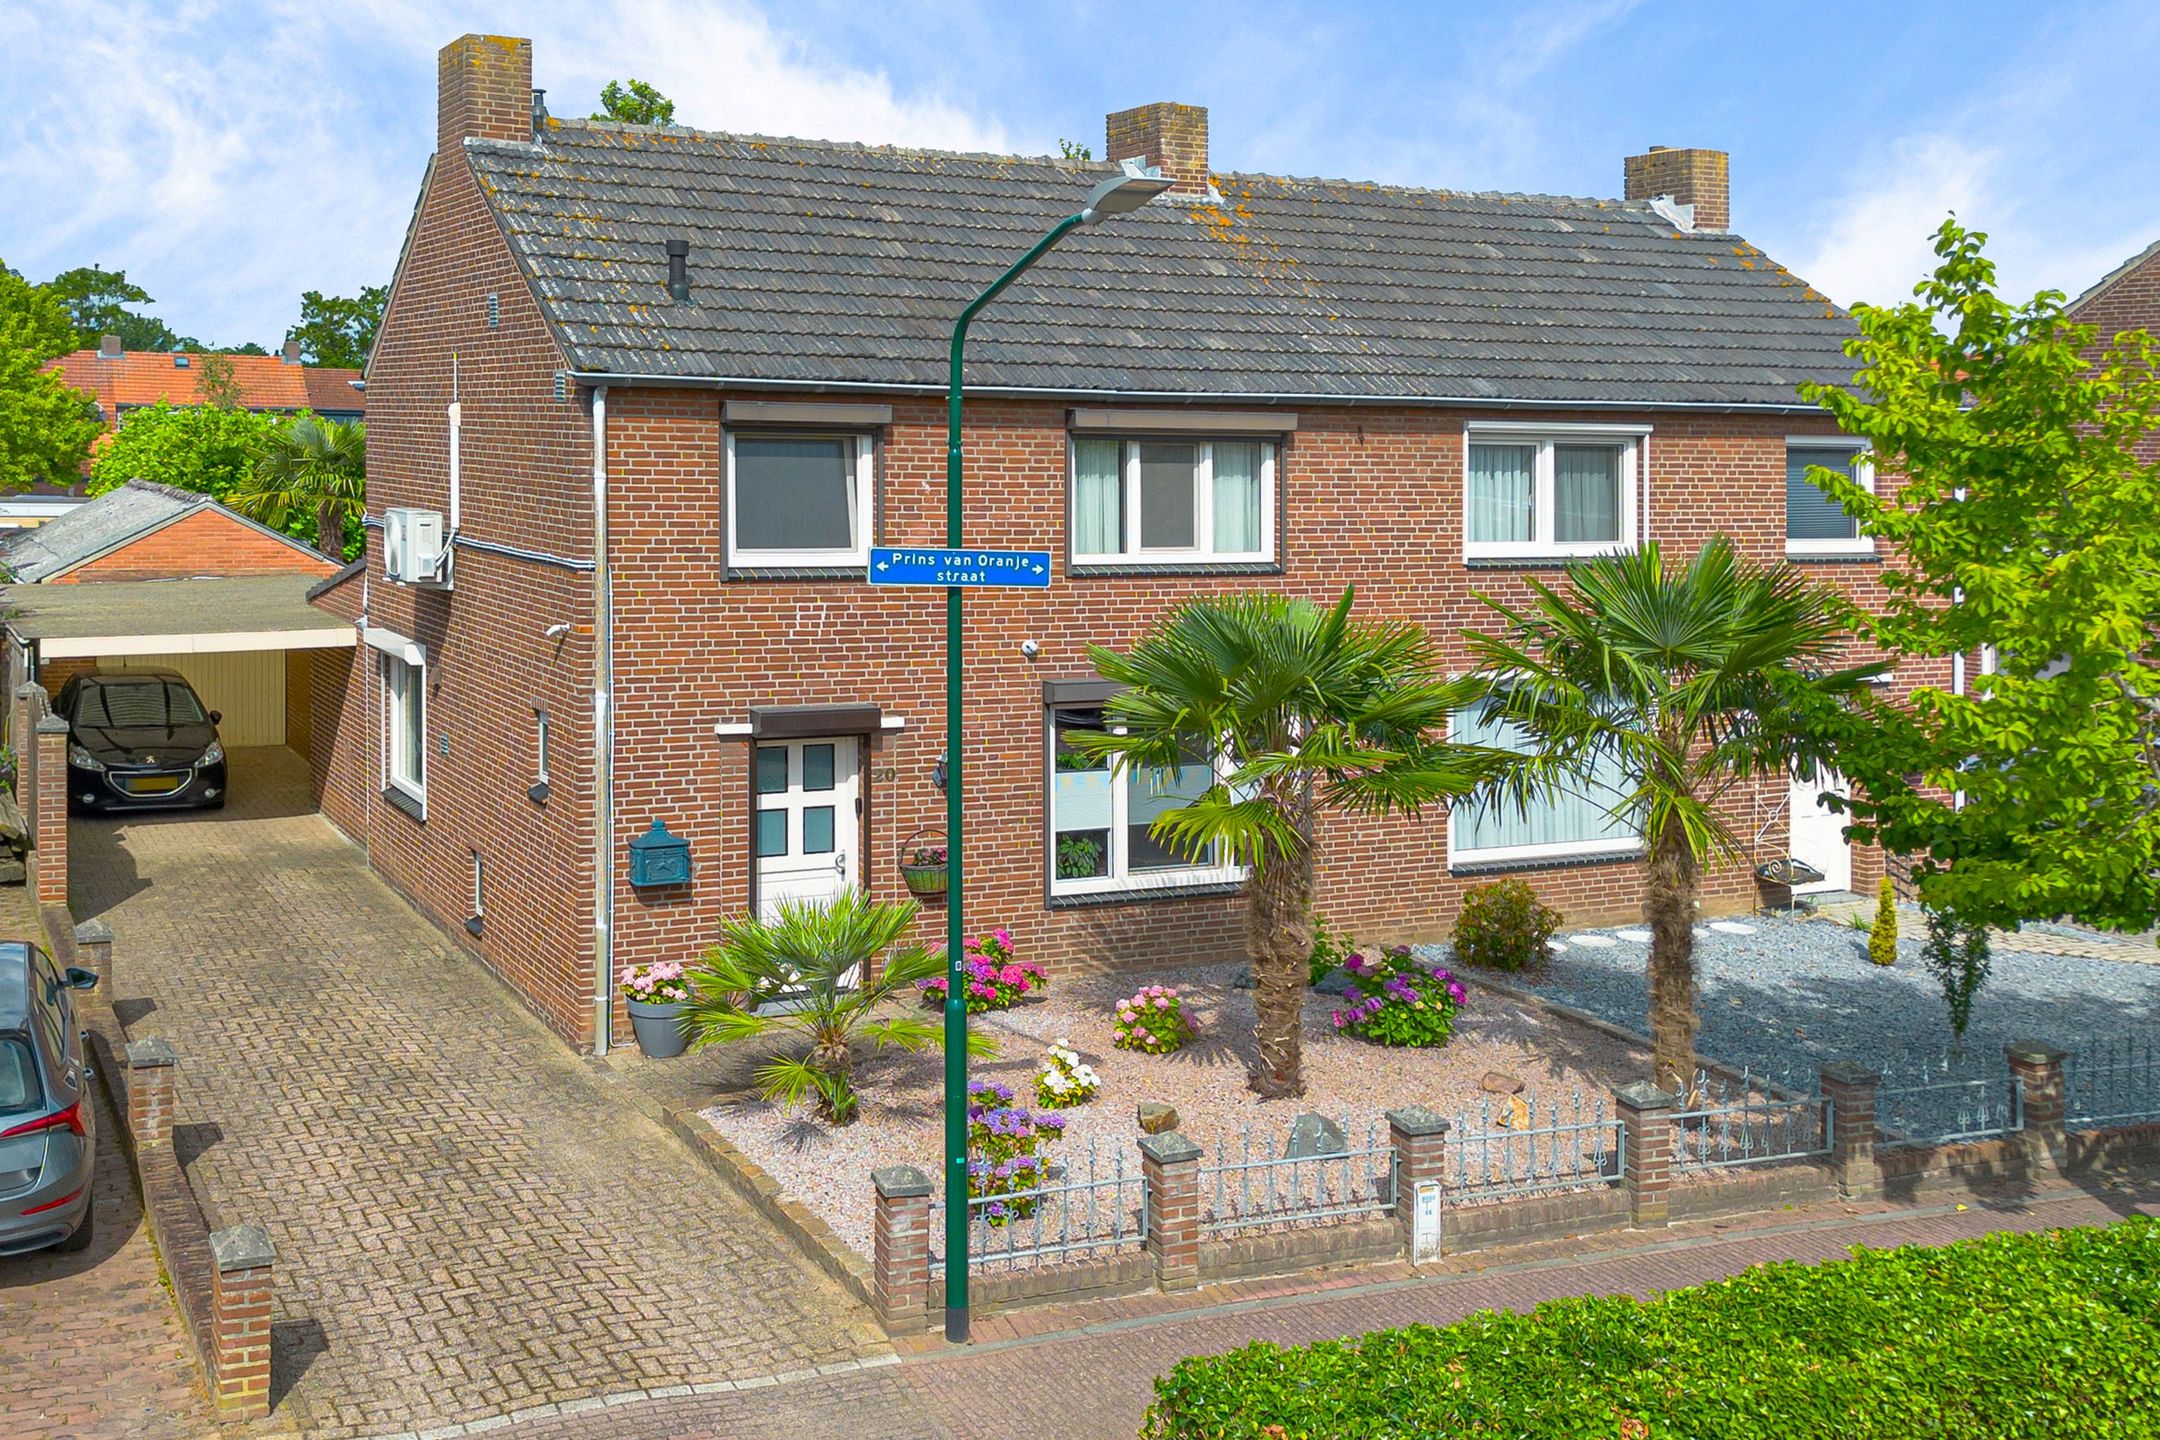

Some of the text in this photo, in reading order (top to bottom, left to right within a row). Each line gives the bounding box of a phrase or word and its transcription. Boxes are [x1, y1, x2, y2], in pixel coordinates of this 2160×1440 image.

[892, 553, 1030, 570] Prins van Oranje
[937, 571, 986, 582] straat
